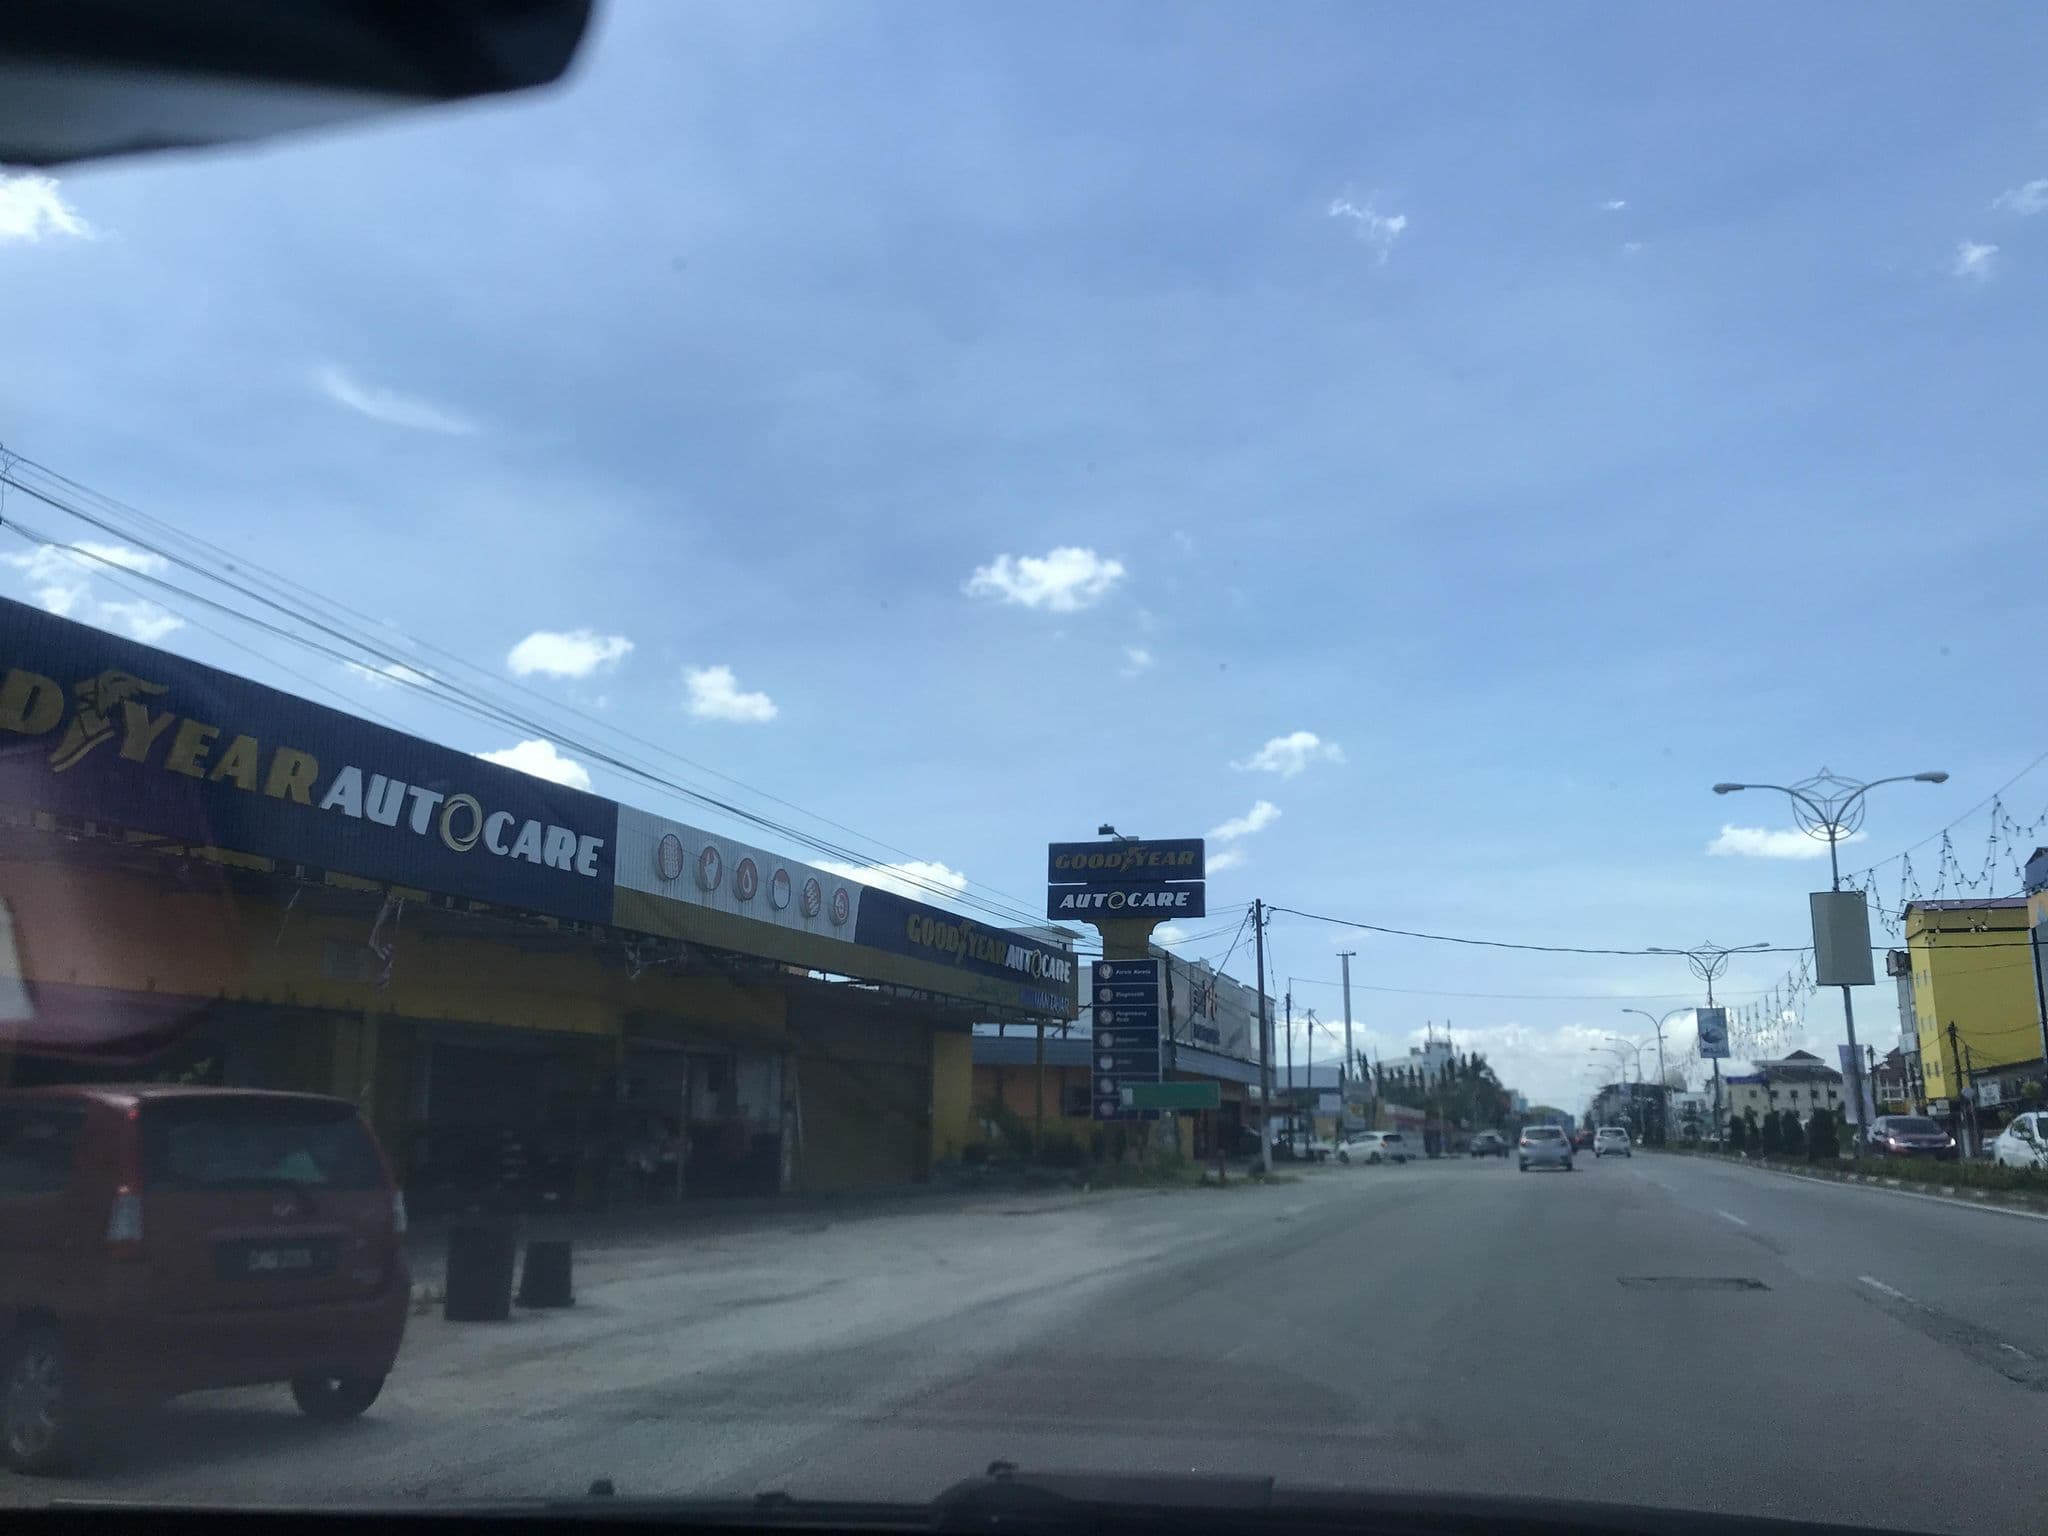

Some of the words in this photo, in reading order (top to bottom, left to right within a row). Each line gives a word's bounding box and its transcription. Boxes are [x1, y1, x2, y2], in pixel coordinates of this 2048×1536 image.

[319, 765, 605, 878] AUTOCARE
[1059, 891, 1191, 910] AUTOCARE
[1005, 944, 1072, 983] AUTOCARE
